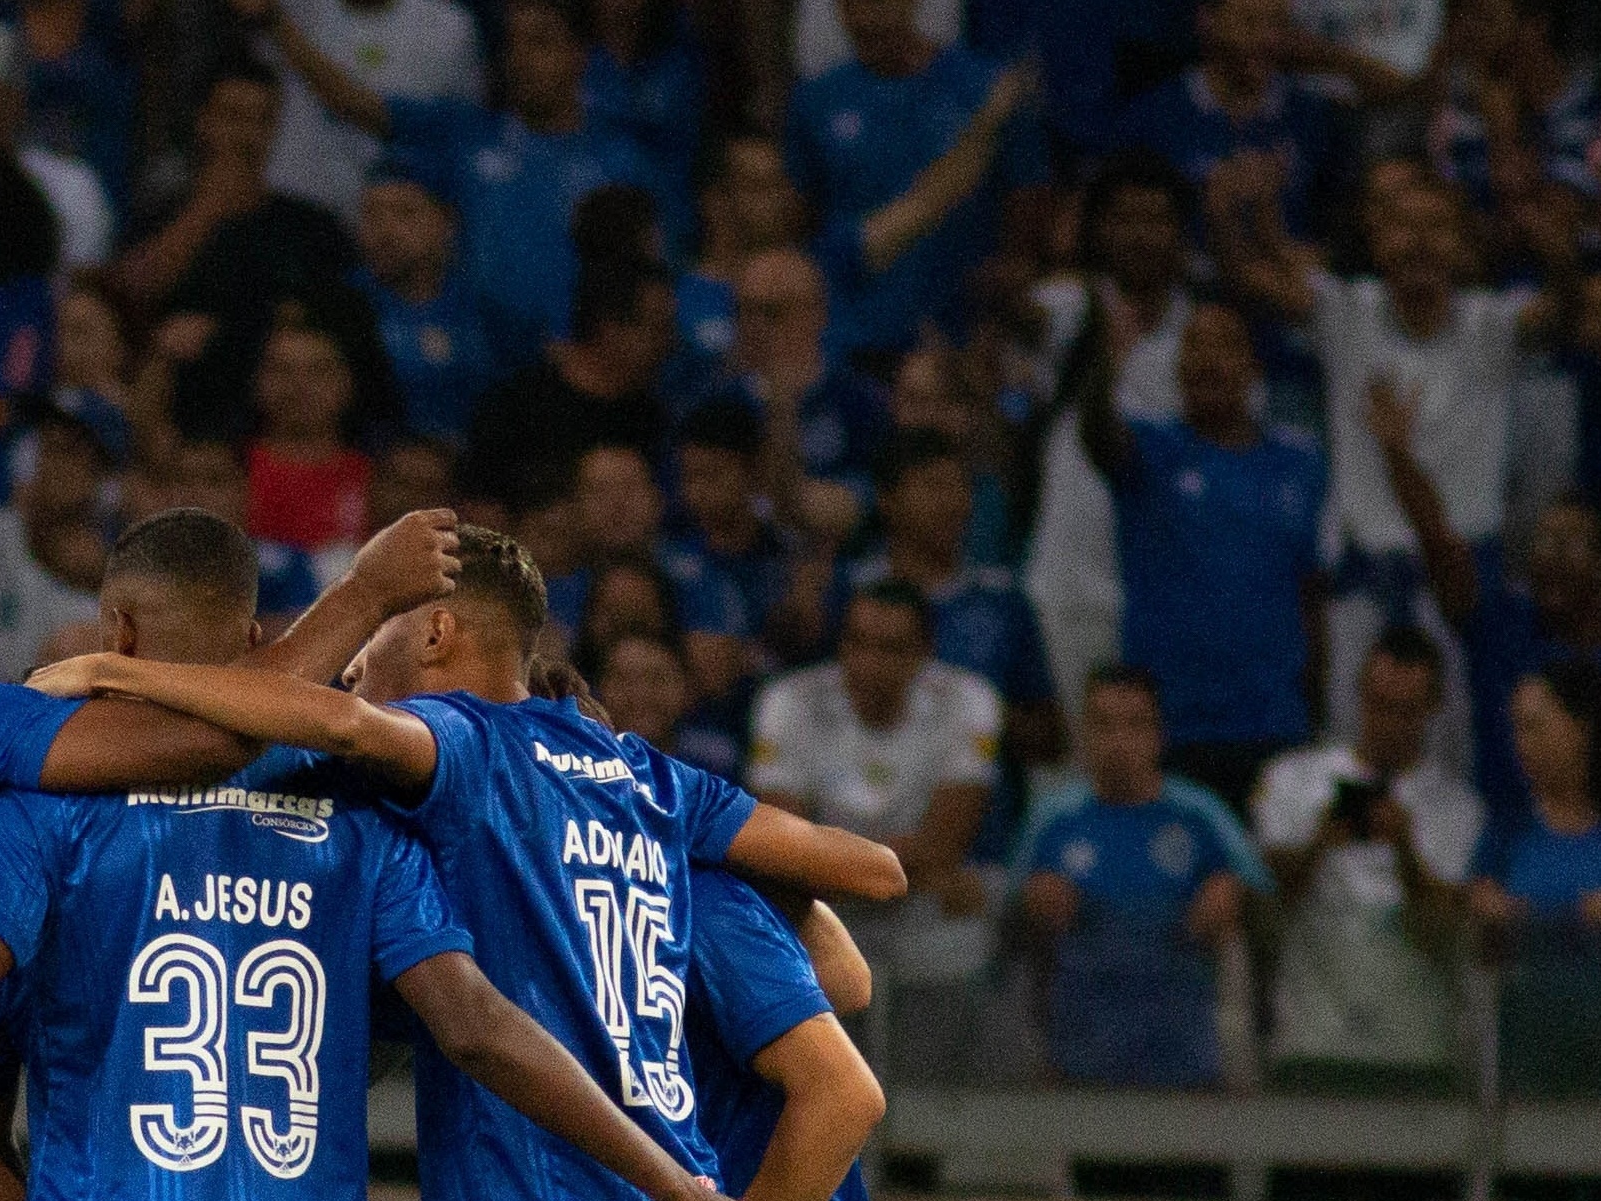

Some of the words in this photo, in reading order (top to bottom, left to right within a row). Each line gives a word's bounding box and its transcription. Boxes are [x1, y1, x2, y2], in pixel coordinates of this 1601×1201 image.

[155, 873, 313, 930] A.JESUS
[575, 879, 695, 1122] 15
[129, 933, 327, 1180] 33
